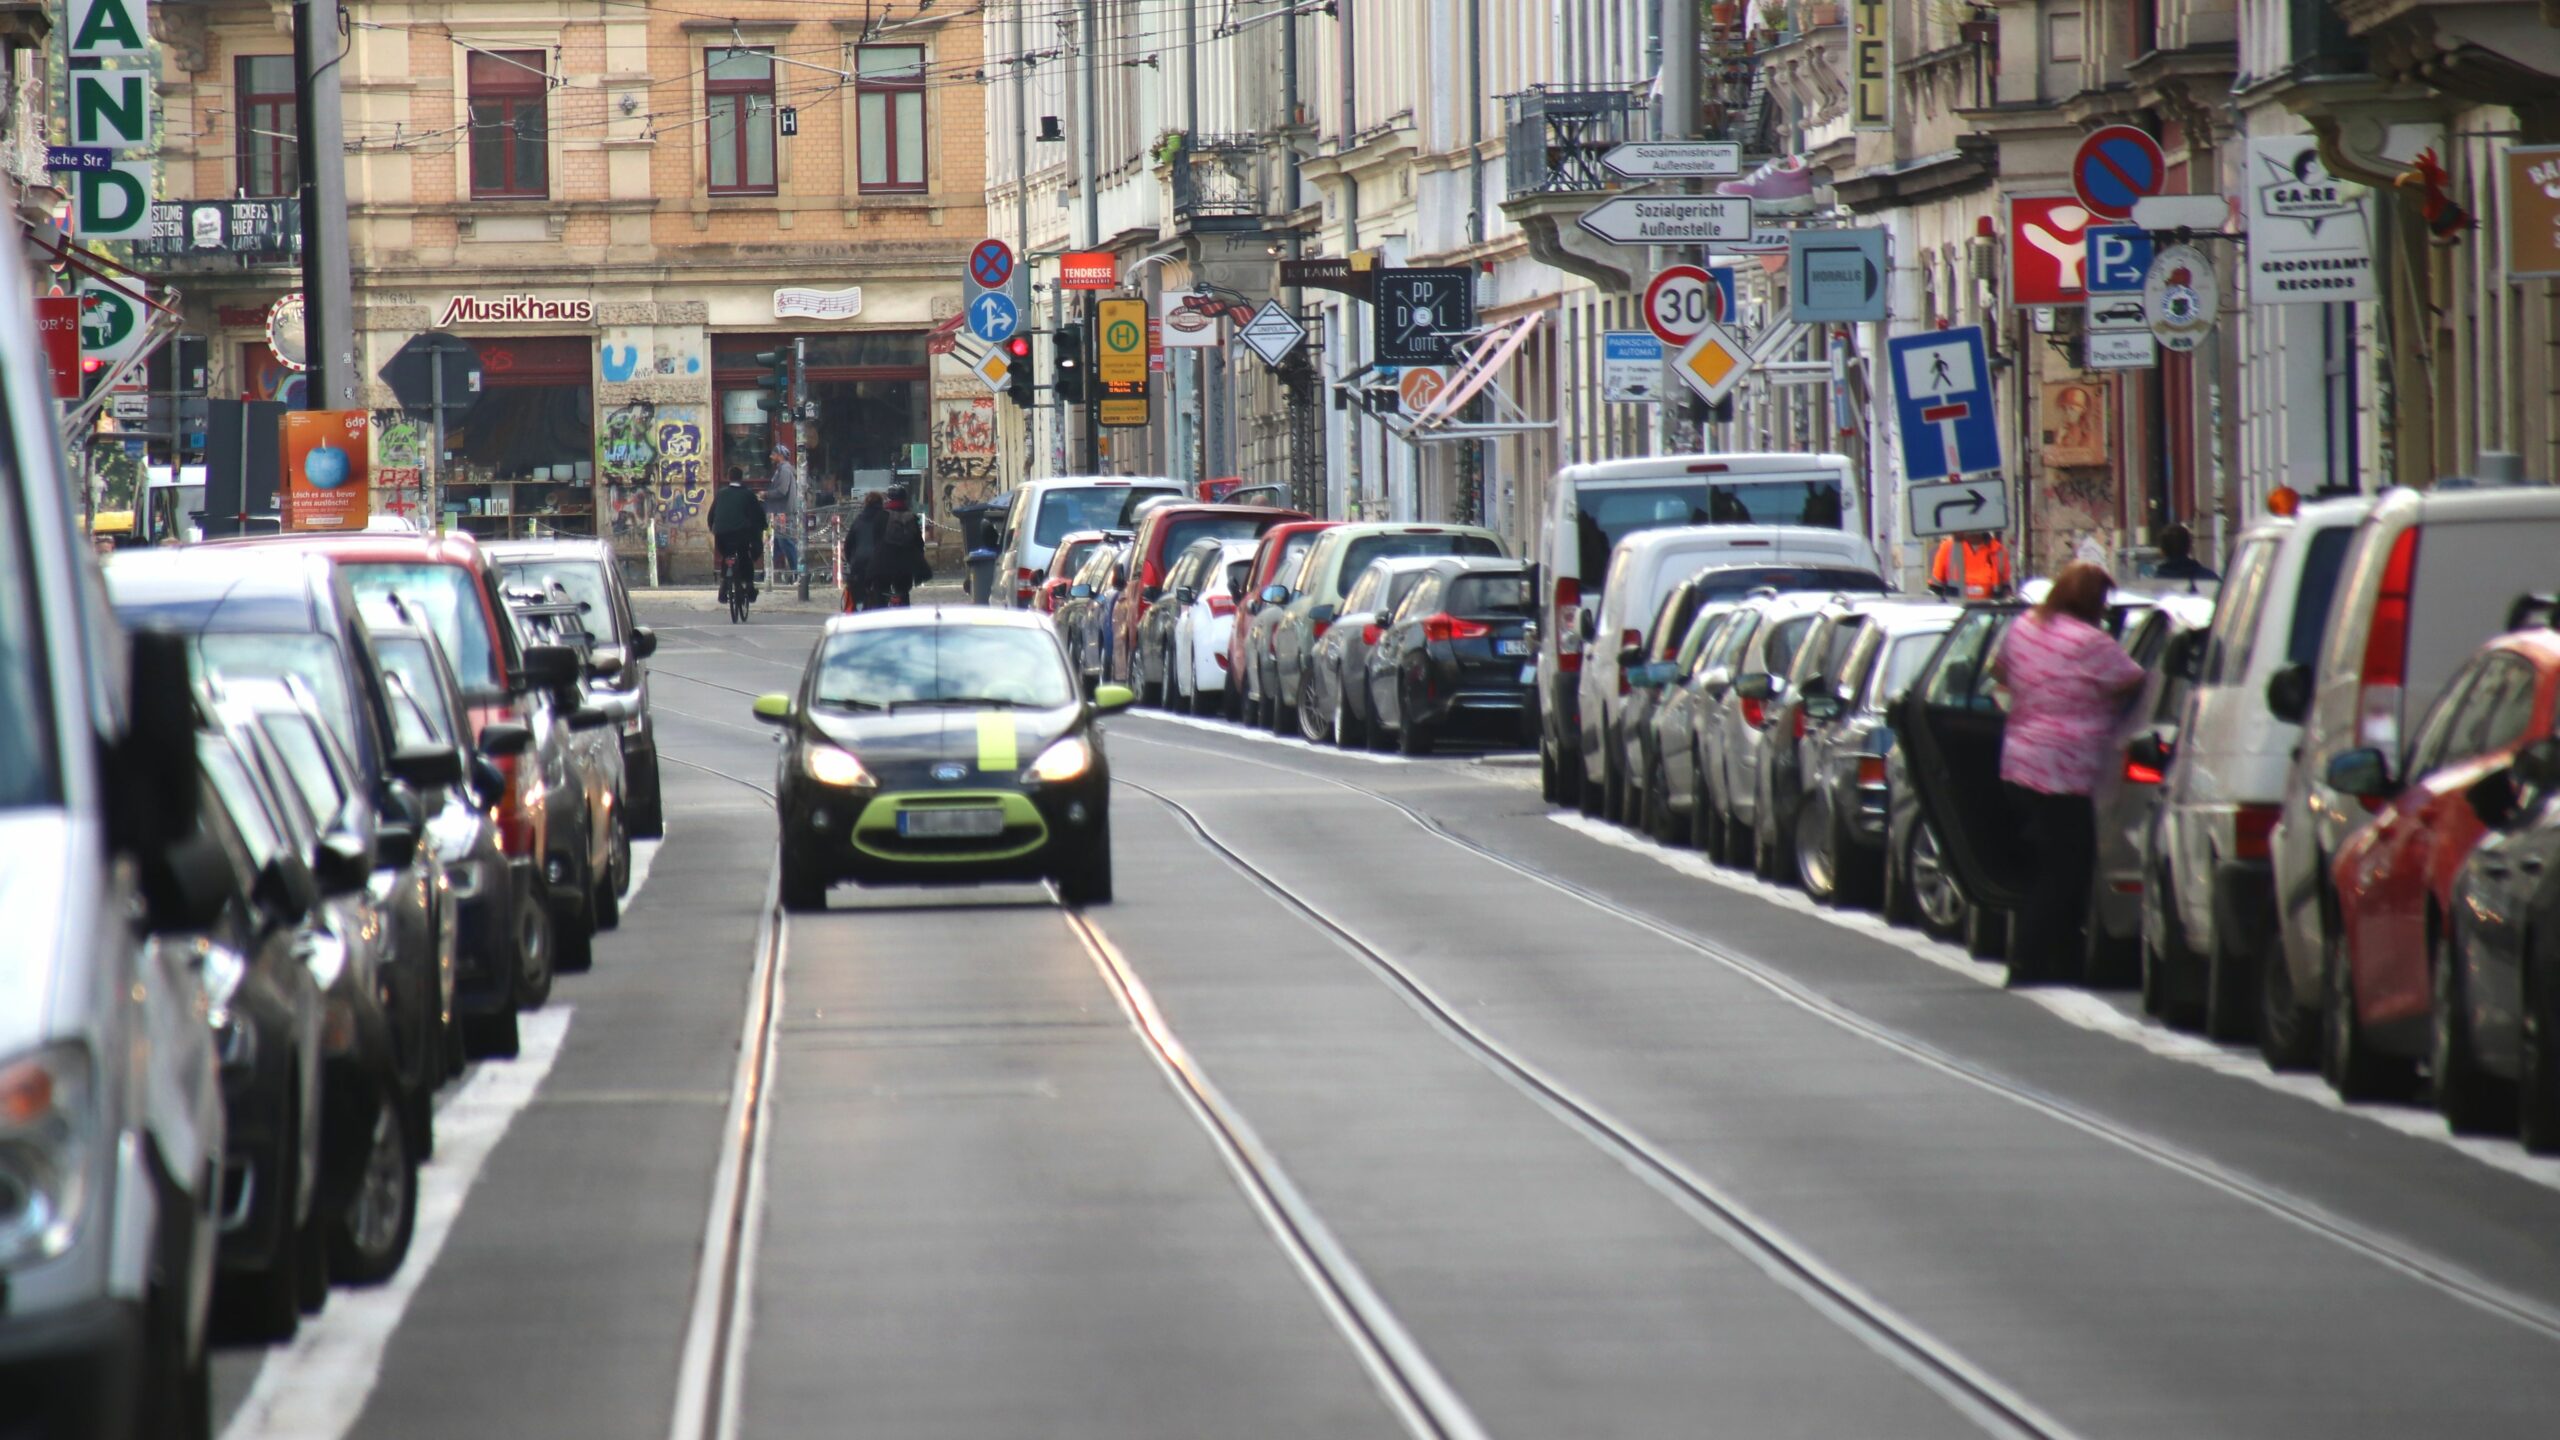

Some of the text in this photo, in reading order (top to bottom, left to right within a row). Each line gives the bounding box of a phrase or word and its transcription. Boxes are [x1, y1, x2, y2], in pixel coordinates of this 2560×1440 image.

[782, 113, 795, 131] H
[83, 153, 105, 167] Str.
[1636, 147, 1732, 158] Sozialministerium
[1652, 160, 1716, 171] Außenstelle
[231, 203, 268, 220] TICKETS
[1635, 202, 1726, 220] Sozialgericht
[231, 220, 253, 236] HIER
[1639, 221, 1722, 237] Außenstelle
[2096, 233, 2132, 284] P
[1064, 268, 1111, 278] TENDRESSE
[2278, 277, 2355, 290] RECORDS
[1413, 281, 1433, 303] PP
[438, 296, 592, 326] Musikhaus
[1661, 288, 1706, 324] 30
[1116, 327, 1131, 346] H
[1409, 336, 1440, 351] LOTTE
[1617, 347, 1657, 356] AUTOMAT
[2093, 351, 2151, 361] Parkschein
[345, 416, 366, 429] ödp
[336, 490, 356, 498] bevor
[314, 499, 349, 507] auslöscht!
